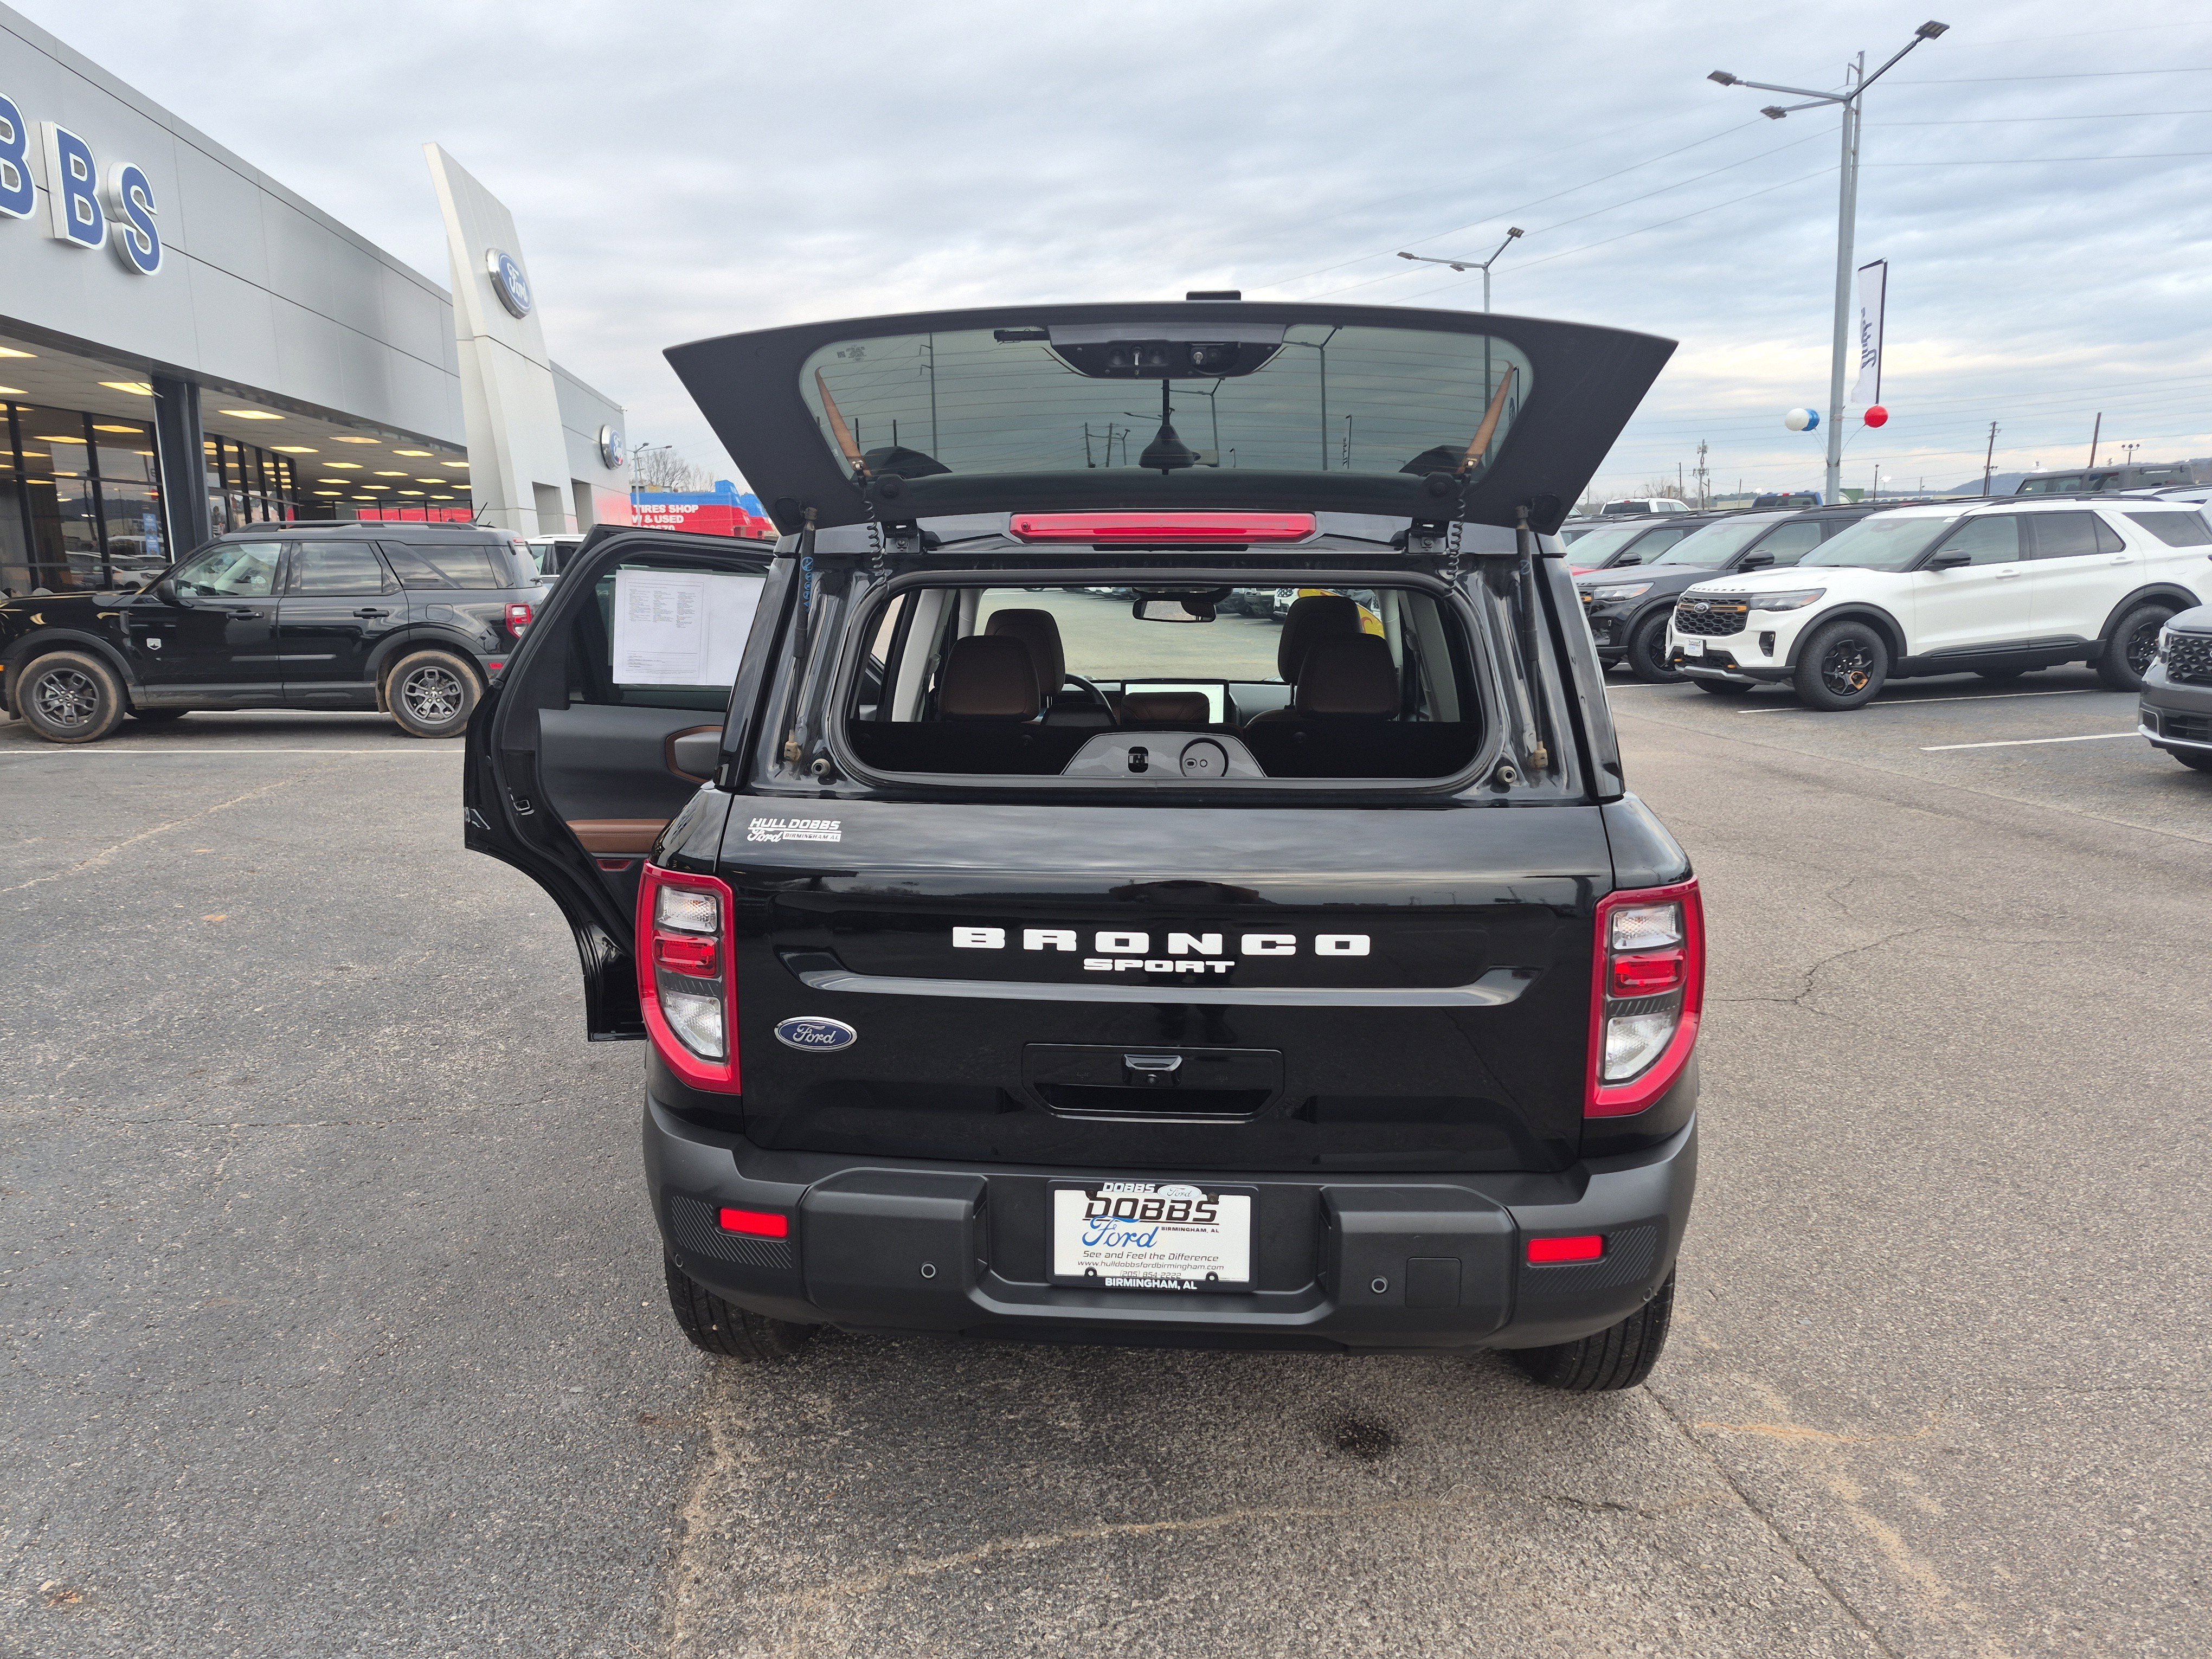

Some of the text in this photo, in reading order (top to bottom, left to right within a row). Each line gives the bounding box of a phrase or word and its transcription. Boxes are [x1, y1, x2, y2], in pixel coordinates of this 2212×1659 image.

[0, 92, 163, 276] BBS
[506, 262, 529, 304] Ford
[633, 504, 699, 514] TIRES SHOP
[654, 515, 685, 524] USED
[749, 818, 841, 830] HULL DOBBS
[747, 828, 783, 843] Ford
[953, 926, 1371, 956] BRONCO
[1083, 958, 1236, 974] SPORT
[792, 1024, 837, 1044] Ford
[1102, 1182, 1193, 1198] DOBBS Ford
[1084, 1197, 1219, 1222] DOBBS
[1082, 1215, 1160, 1248] Ford
[1149, 1252, 1166, 1261] the
[1168, 1253, 1219, 1262] Difference
[1077, 1260, 1225, 1271] www.hulldobbsfordbirmingham.com
[1142, 1271, 1181, 1279] 854-2222
[1105, 1277, 1198, 1290] BIRMINGHAM, AL
